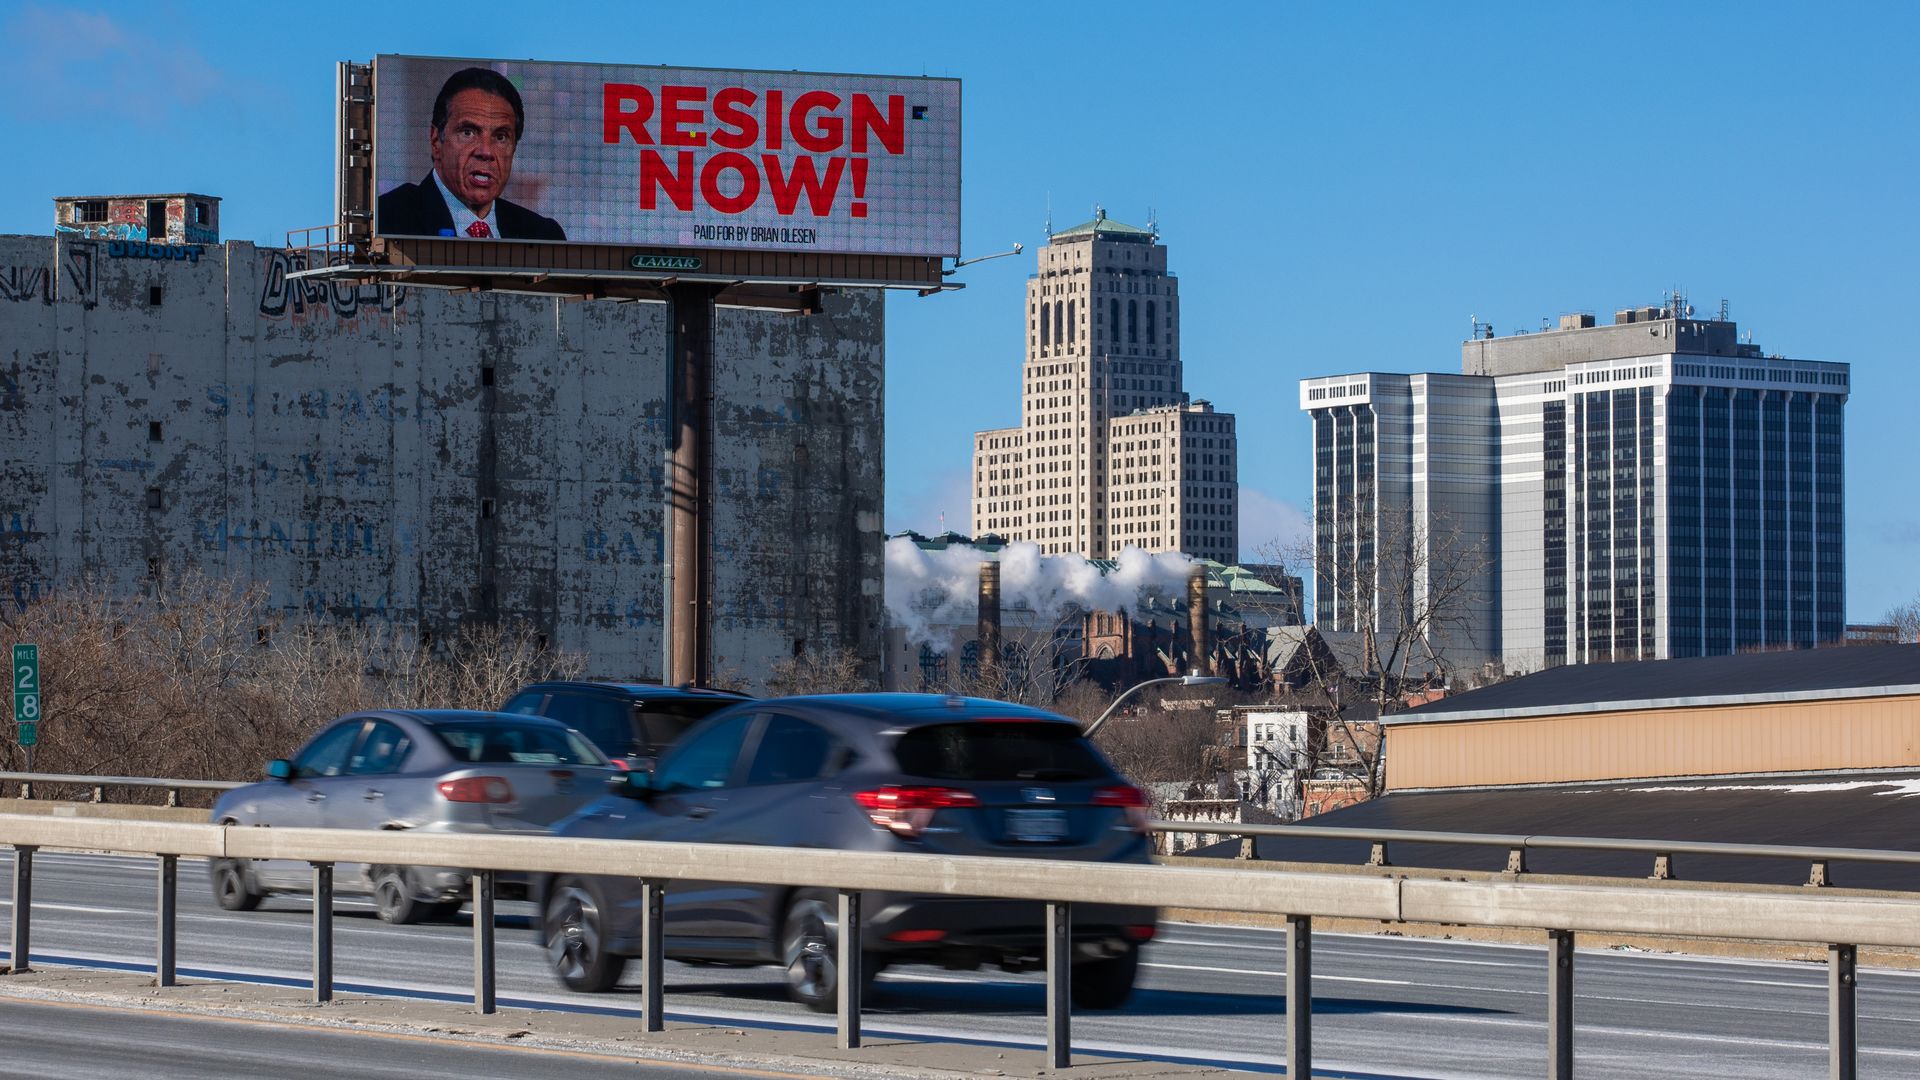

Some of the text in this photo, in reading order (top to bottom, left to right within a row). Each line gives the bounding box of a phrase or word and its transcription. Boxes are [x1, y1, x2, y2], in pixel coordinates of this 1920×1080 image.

[603, 83, 905, 155] RESIGN
[639, 149, 869, 218] NOW!
[693, 225, 816, 244] PAID FOR BY BRIAN OLESEN
[637, 257, 695, 268] LAMAR
[17, 650, 35, 660] MILE
[18, 665, 34, 689] 2
